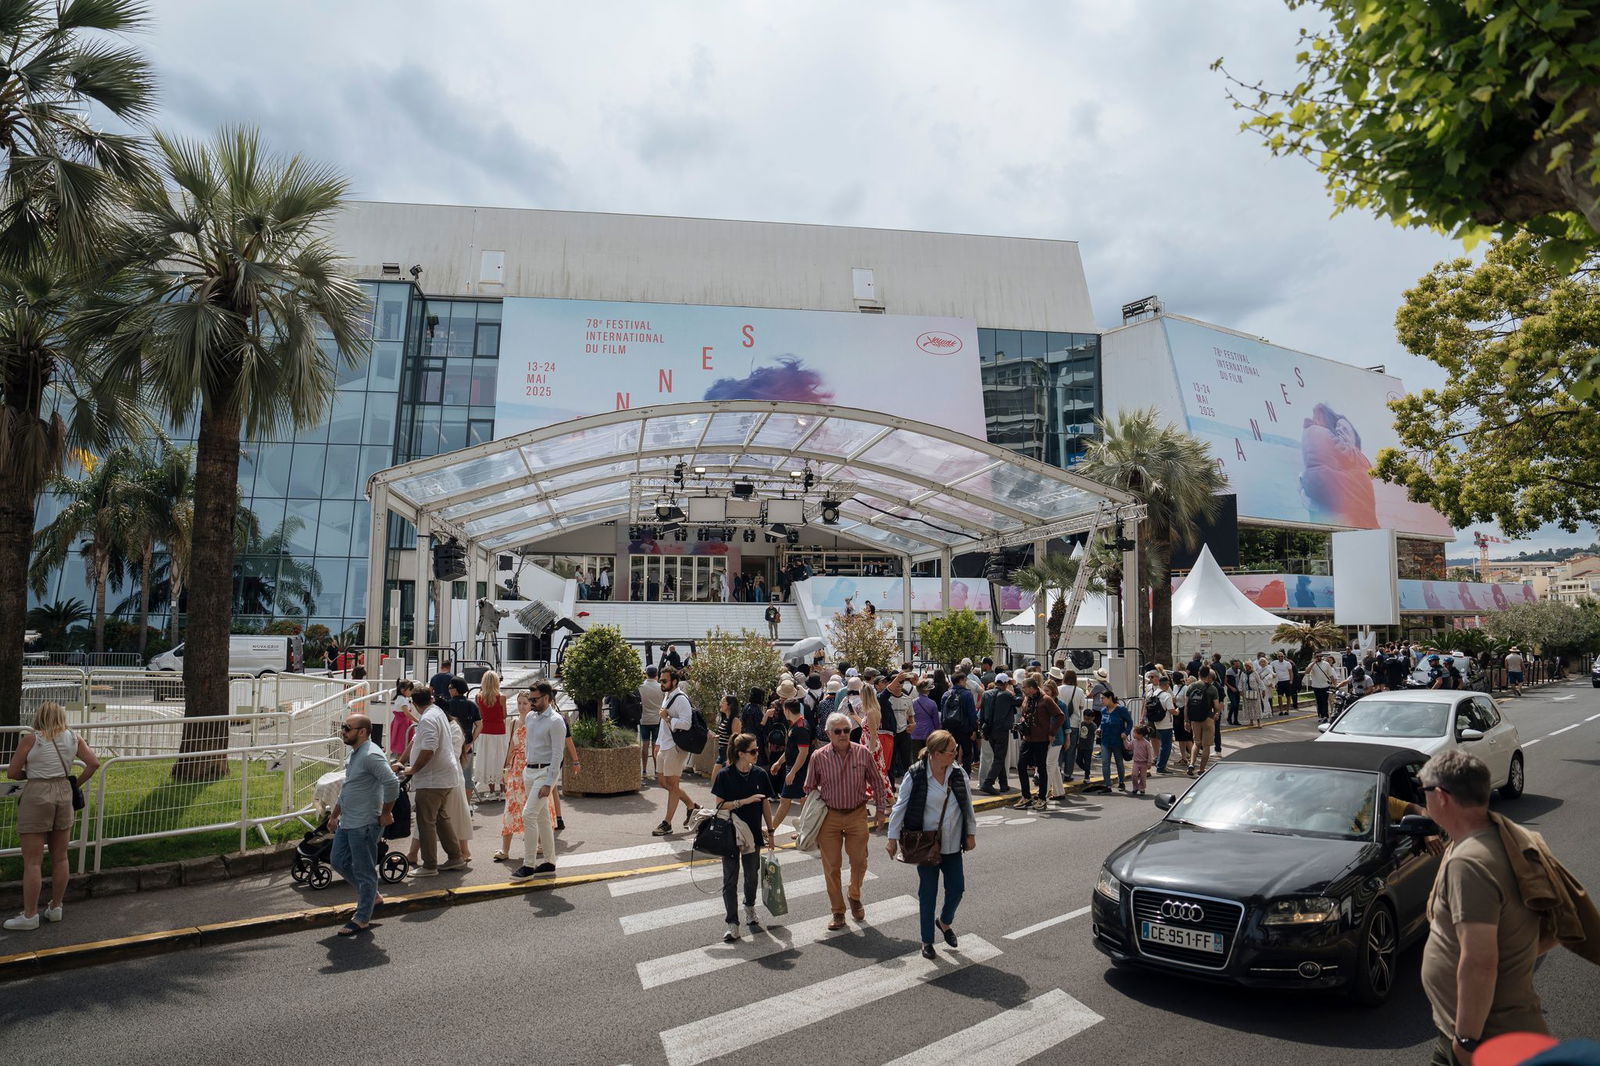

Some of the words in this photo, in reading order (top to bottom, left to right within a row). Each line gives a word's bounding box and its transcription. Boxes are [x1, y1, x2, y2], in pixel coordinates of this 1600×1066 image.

[606, 319, 652, 330] FESTIVAL
[586, 331, 665, 344] INTERNATIONAL
[585, 343, 599, 354] DU
[602, 344, 626, 354] FILM
[1223, 349, 1250, 364] FESTIVAL
[527, 362, 556, 372] 13-24
[1216, 359, 1260, 377] INTERNATIONAL
[526, 373, 546, 384] MAI
[1228, 372, 1243, 384] FILM
[526, 386, 552, 397] 2025
[1193, 382, 1210, 394] 13-24
[1196, 393, 1208, 405] MAI
[1199, 406, 1215, 417] 2025
[1151, 926, 1211, 948] CE-951-FF
